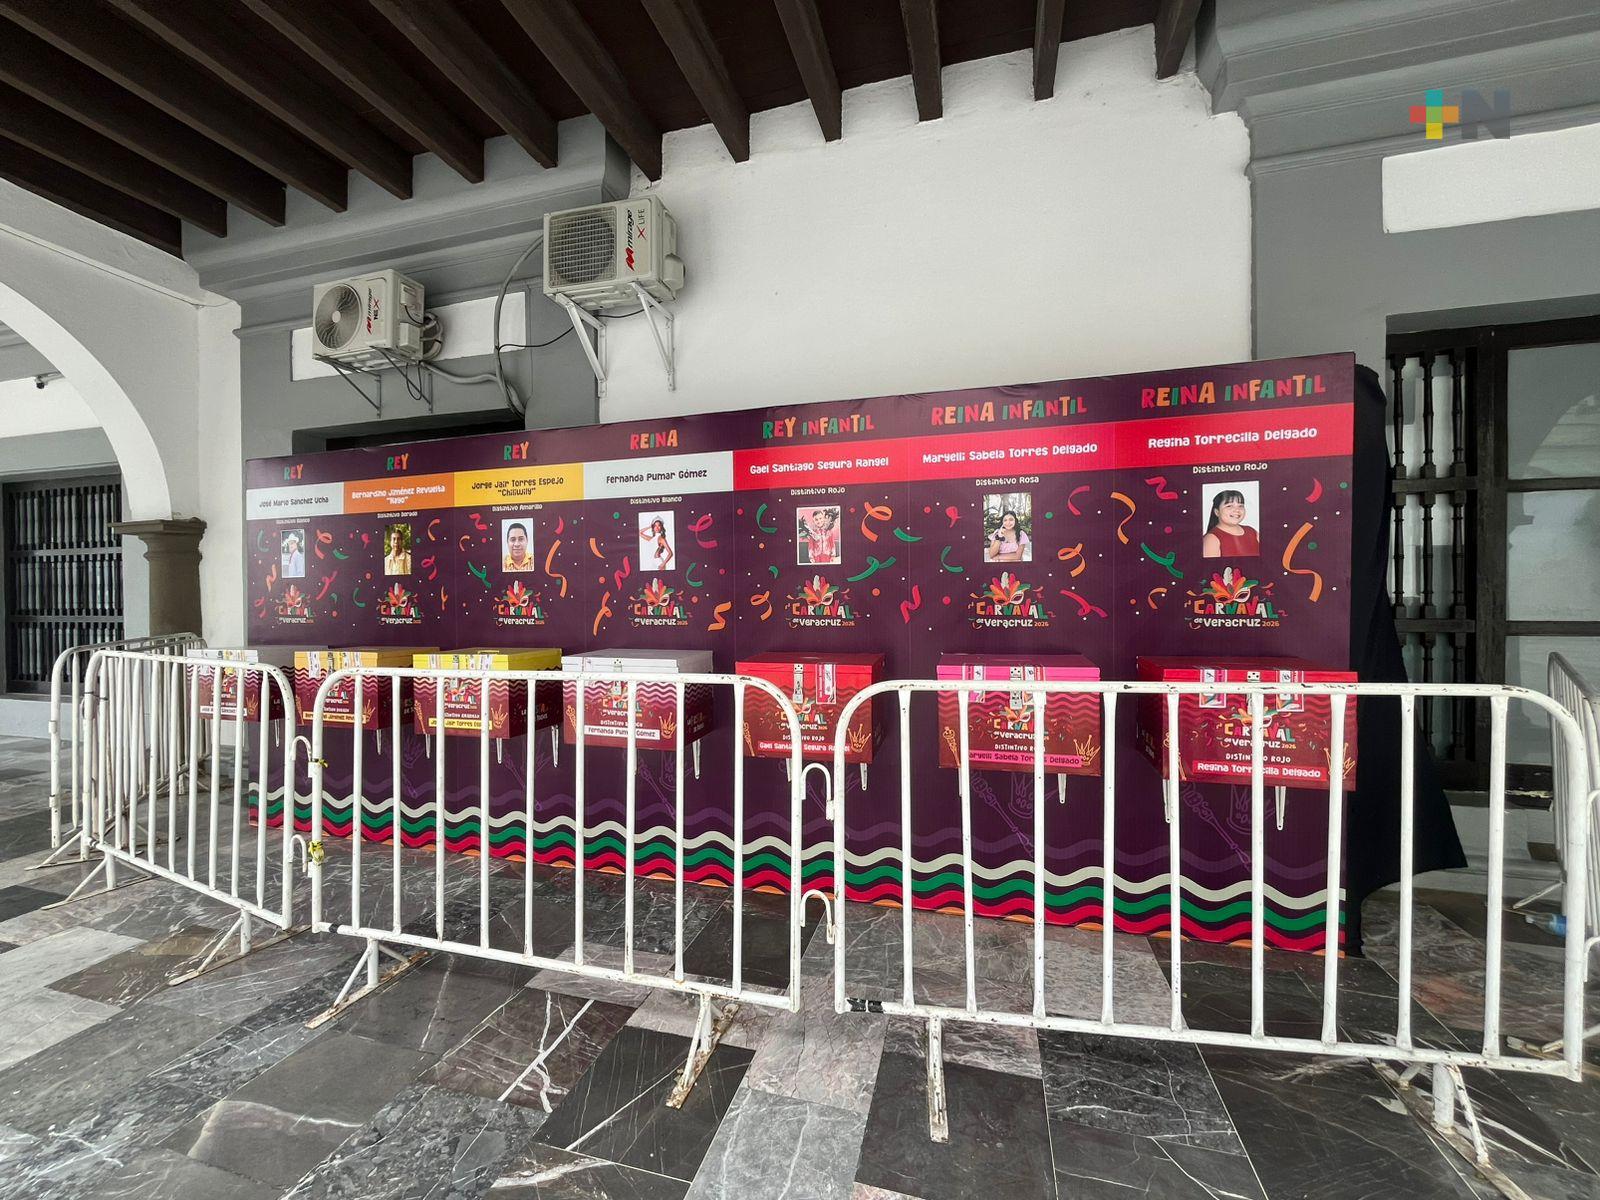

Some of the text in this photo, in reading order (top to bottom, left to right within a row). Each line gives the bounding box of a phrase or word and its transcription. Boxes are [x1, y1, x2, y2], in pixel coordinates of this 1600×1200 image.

[1141, 374, 1326, 409] REINA INFANTIL
[931, 396, 1088, 426] REINA INFANTIL
[762, 414, 875, 439] REY INFANTIL
[630, 429, 678, 450] REINA
[1148, 427, 1318, 449] Regina Torrecilla Delgado
[503, 441, 529, 460] REY
[922, 443, 1098, 464] Maryelli Sabela Torres Delgado
[386, 453, 409, 471] REY
[750, 457, 889, 474] Gael Santiago Segura Rangel
[1193, 462, 1268, 474] Distintivo Rojo
[283, 463, 304, 480] REY
[606, 468, 708, 484] Fernanda Pumar Gómez
[471, 481, 493, 490] Jorge
[511, 478, 537, 488] Torres
[538, 476, 564, 486] Espejo
[975, 476, 1040, 487] Distintivo Rosa
[790, 488, 826, 496] Distintivo
[792, 600, 854, 619] CARNAVAL
[976, 598, 1049, 620] CARNAVAL
[1193, 595, 1279, 619] CARNAVAL
[799, 618, 841, 627] Veracruz
[984, 618, 1033, 628] Veracruz
[1203, 617, 1261, 627] Veracruz
[1197, 762, 1321, 778] Regina Torrcilla Delgado
